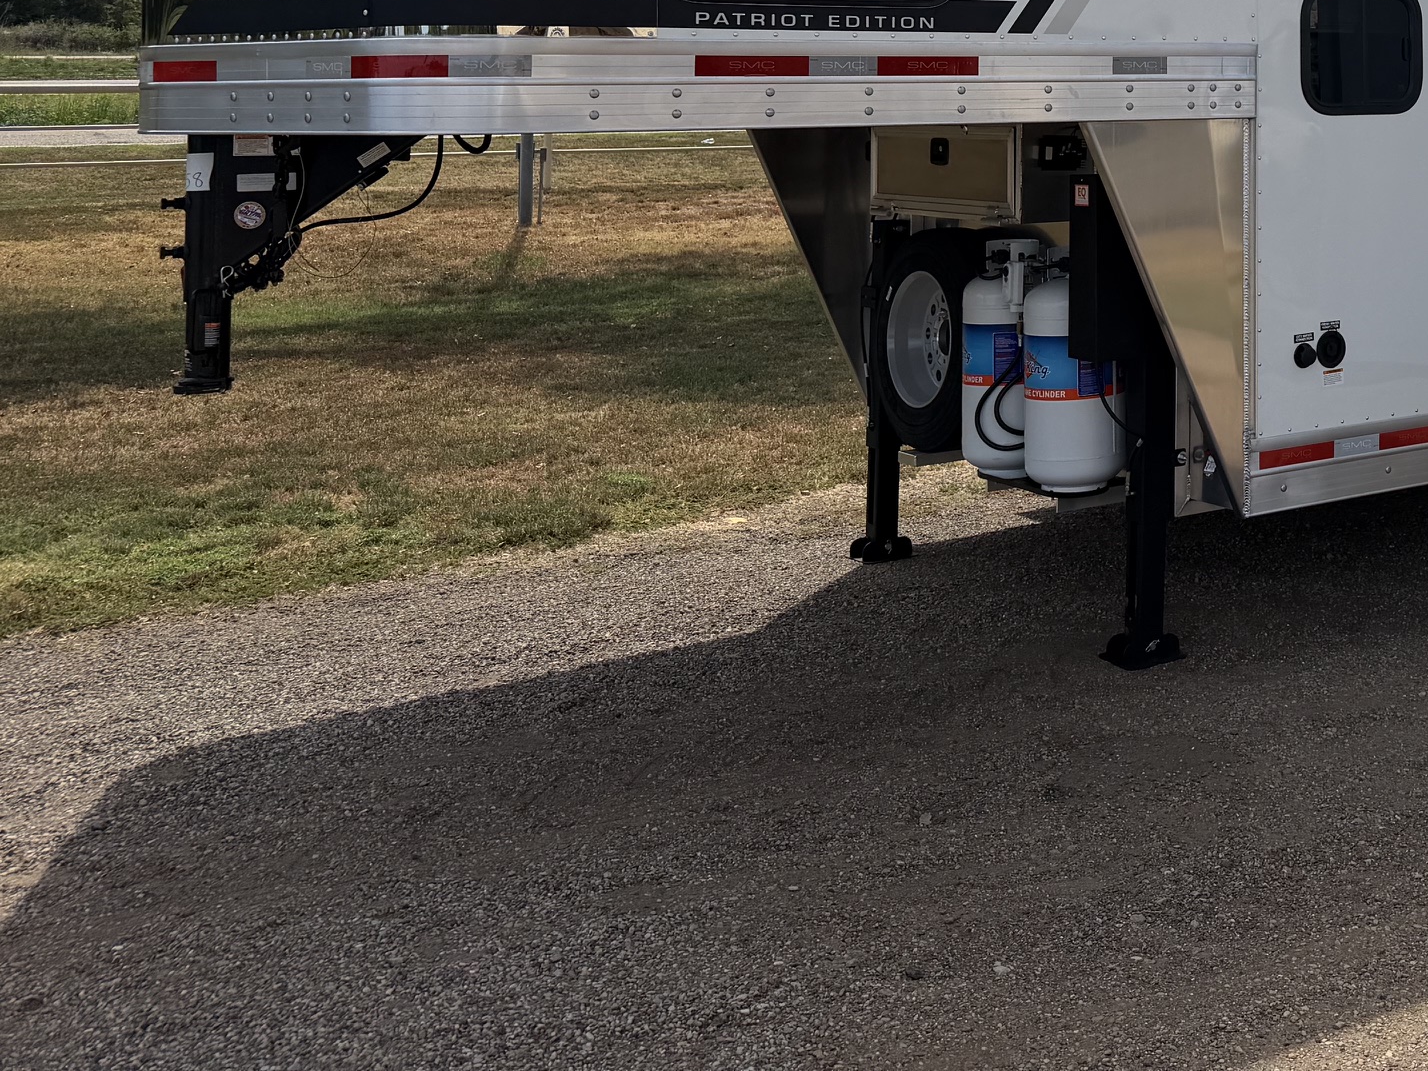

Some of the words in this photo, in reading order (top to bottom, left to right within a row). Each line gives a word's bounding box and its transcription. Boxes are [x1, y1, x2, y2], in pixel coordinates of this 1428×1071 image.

[694, 11, 814, 27] PATRIOT
[828, 14, 936, 29] EDITION
[463, 60, 518, 70] SMC
[729, 60, 776, 70] SMC
[821, 61, 865, 70] SMC
[907, 61, 949, 69] SMC
[1122, 61, 1158, 69] SMC
[1077, 187, 1087, 200] EQ
[1031, 390, 1066, 398] CYLINDER
[1343, 439, 1372, 450] SMC
